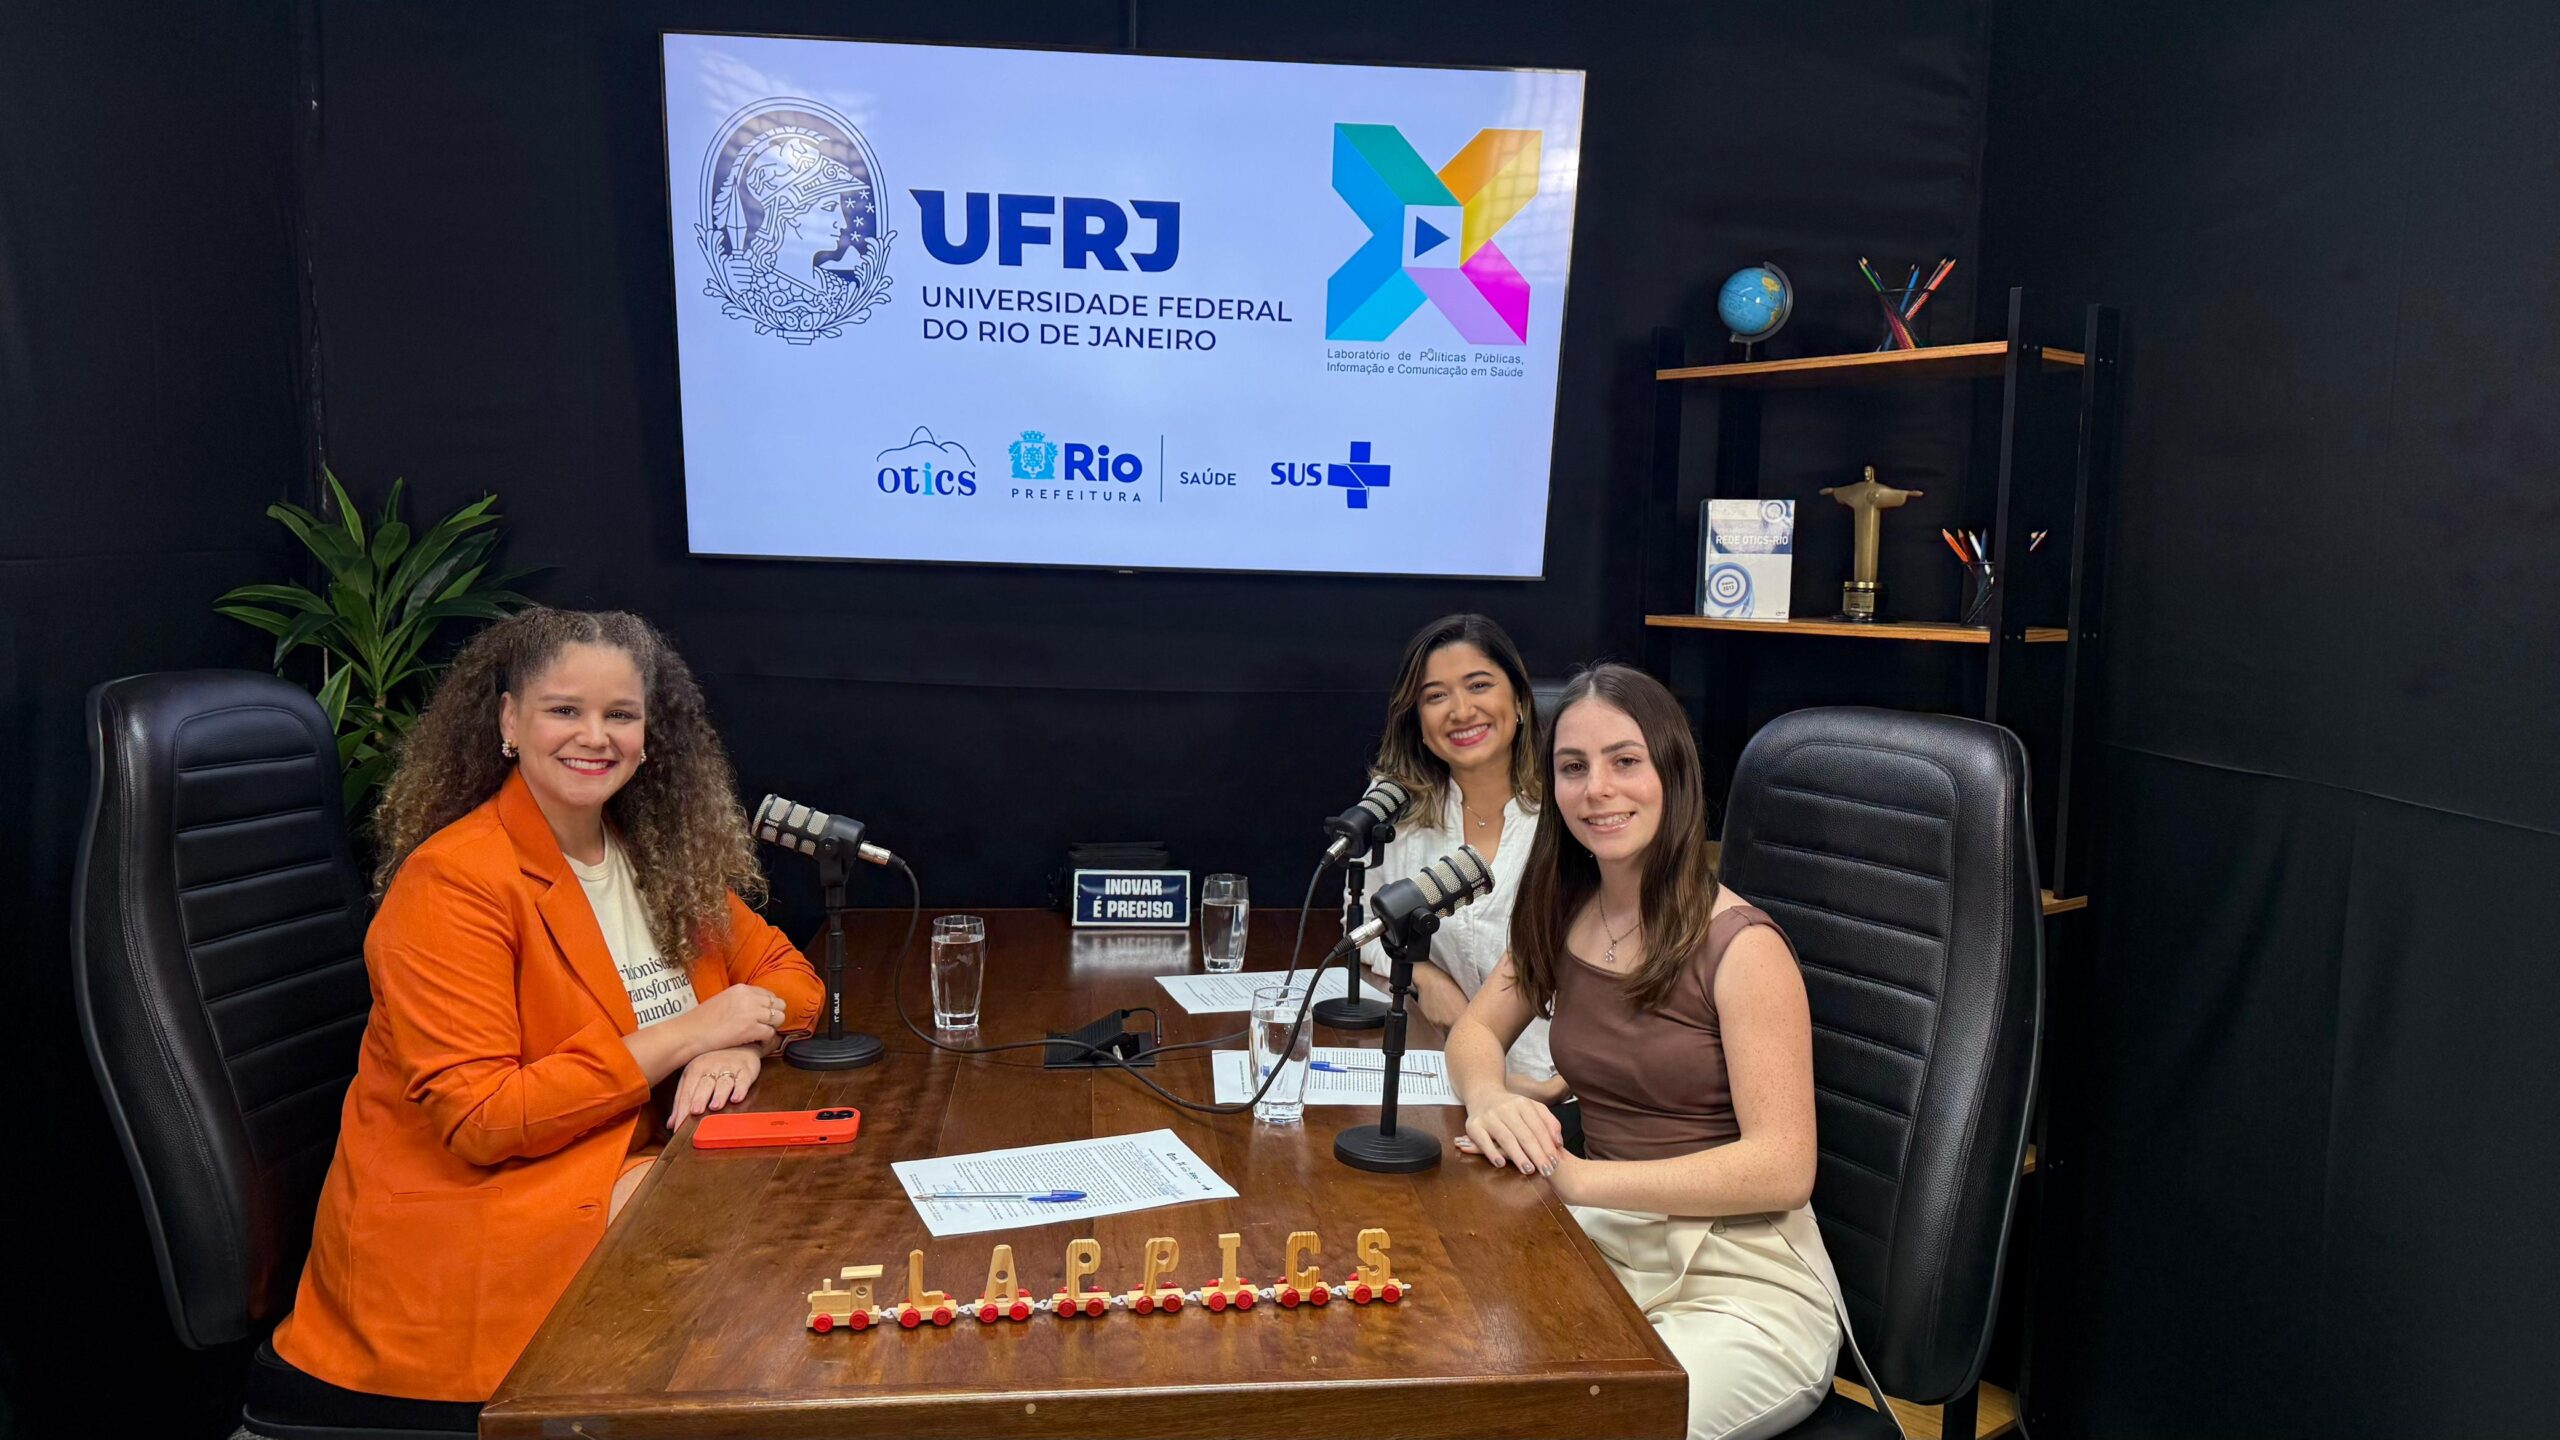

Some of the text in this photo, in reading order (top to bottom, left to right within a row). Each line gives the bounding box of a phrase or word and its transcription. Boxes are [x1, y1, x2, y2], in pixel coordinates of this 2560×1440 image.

[909, 188, 1181, 272] UFRJ
[922, 285, 1293, 323] UNIVERSIDADE FEDERAL
[922, 318, 1217, 351] DO RIO DE JANEIRO
[1327, 349, 1390, 360] Laboratório
[1397, 350, 1412, 361] de
[1474, 352, 1525, 365] Públicas,
[1327, 362, 1524, 377] Informação e Comunicação em Saúde
[1063, 442, 1237, 487] Rio SAÚDE
[1270, 461, 1323, 487] SUS
[876, 461, 977, 496] otics
[1011, 487, 1142, 503] PREFEITURA
[1716, 536, 1741, 545] REDE
[1105, 878, 1163, 895] INOVAR
[1092, 895, 1174, 919] É PRECISO
[634, 998, 682, 1025] mundo
[908, 1227, 1392, 1307] LAPPICS
